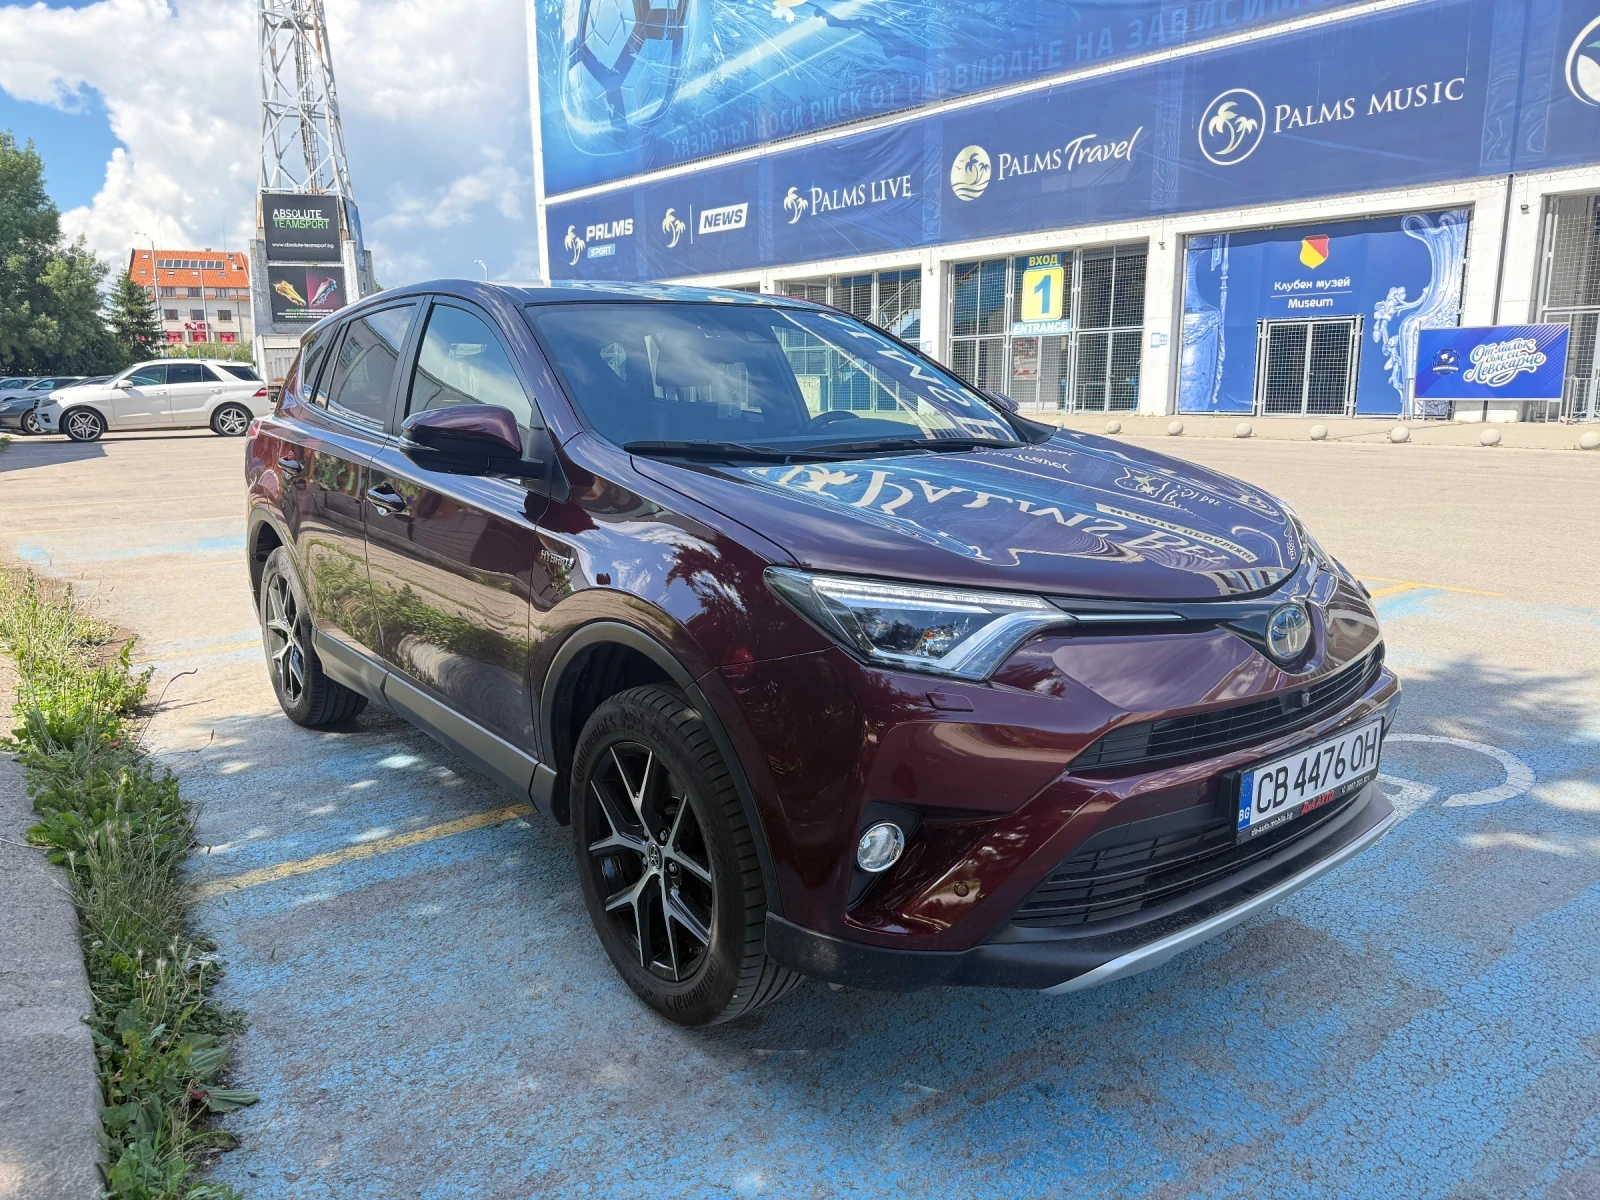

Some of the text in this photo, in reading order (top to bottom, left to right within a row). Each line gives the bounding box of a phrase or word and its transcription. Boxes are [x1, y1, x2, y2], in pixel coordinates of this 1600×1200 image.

[809, 91, 863, 124] РИСК
[908, 39, 1064, 101] РАЗВИВАНЕ
[1075, 26, 1115, 62] НА
[1126, 0, 1326, 50] ЗАВИСИМ
[1273, 76, 1466, 134] PALMS MUSIC
[997, 126, 1145, 181] PALMS Travel
[811, 174, 912, 216] PALMS LIVE
[272, 208, 322, 219] ABSOLUTE
[703, 208, 744, 229] NEWS
[273, 219, 330, 230] TEAMSPORT
[585, 218, 634, 242] PALMS
[590, 245, 613, 258] SPORT
[1028, 255, 1060, 267] ВХОД
[1274, 277, 1351, 293] Клубен музей
[1033, 274, 1054, 315] 1
[1287, 298, 1334, 309] Museum
[1013, 320, 1070, 334] ENTRANCE
[1257, 727, 1377, 814] CB 4476 OH
[1238, 806, 1250, 822] BG
